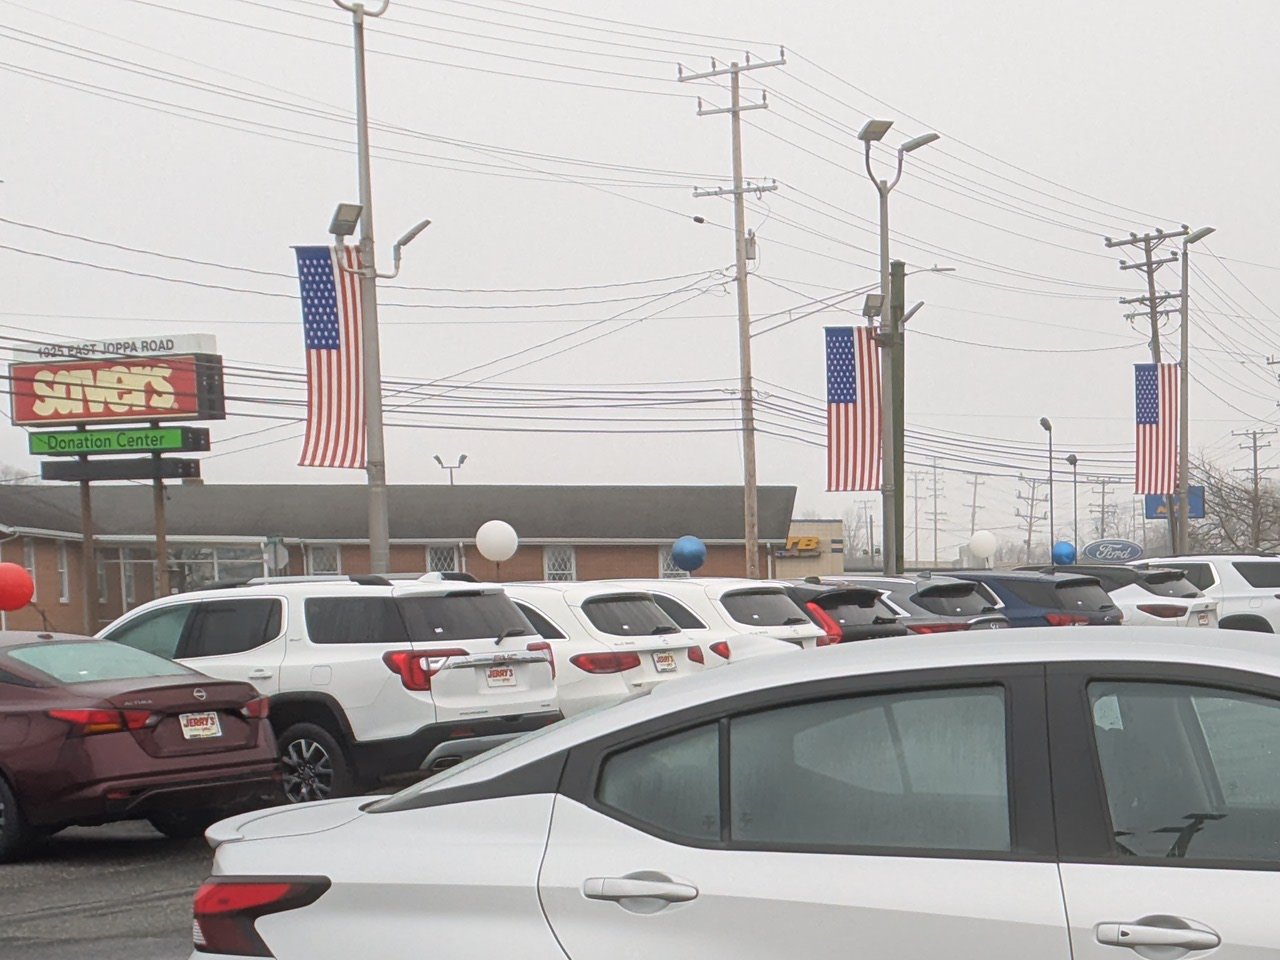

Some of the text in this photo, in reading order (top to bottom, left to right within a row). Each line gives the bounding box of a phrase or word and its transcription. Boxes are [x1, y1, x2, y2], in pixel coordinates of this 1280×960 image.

[68, 343, 97, 356] EAST
[101, 341, 139, 355] JOPPA
[141, 338, 175, 352] ROAD
[47, 431, 166, 450] Donation Center
[1096, 543, 1132, 560] Ford
[487, 668, 514, 679] JERRY'S
[183, 715, 216, 728] JERRY'S
